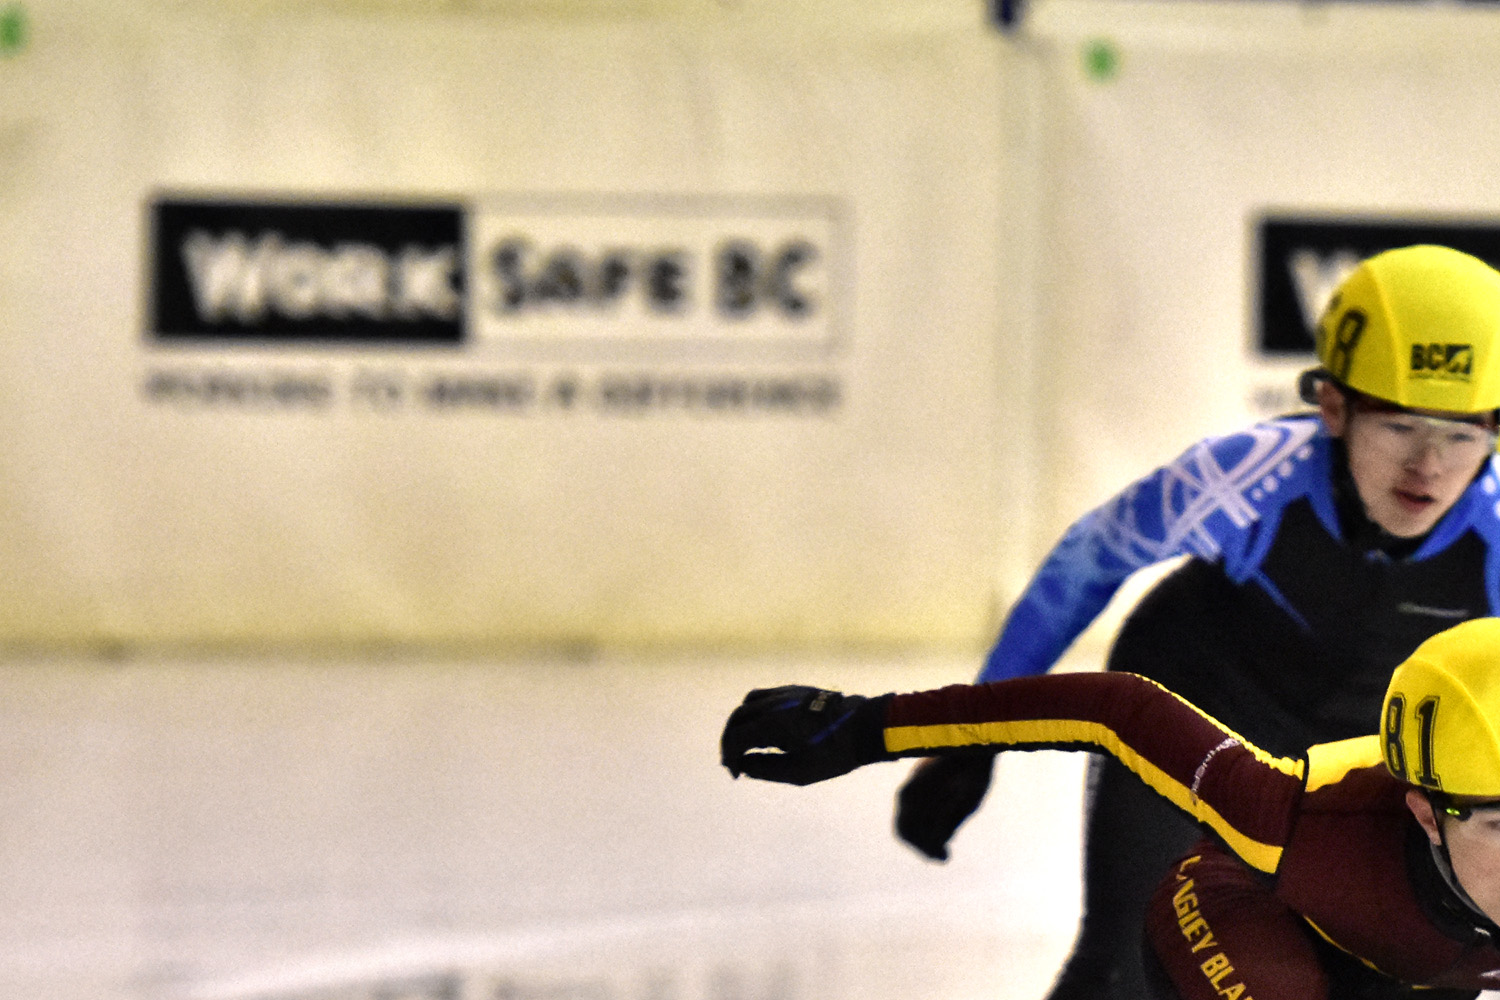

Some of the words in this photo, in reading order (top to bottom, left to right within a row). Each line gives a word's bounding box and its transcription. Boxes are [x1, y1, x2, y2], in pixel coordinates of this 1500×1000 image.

[182, 230, 462, 321] WORK
[491, 232, 690, 318] SAFE
[713, 237, 820, 319] BC
[1386, 692, 1442, 791] 81
[1173, 855, 1218, 953] LNGLEY
